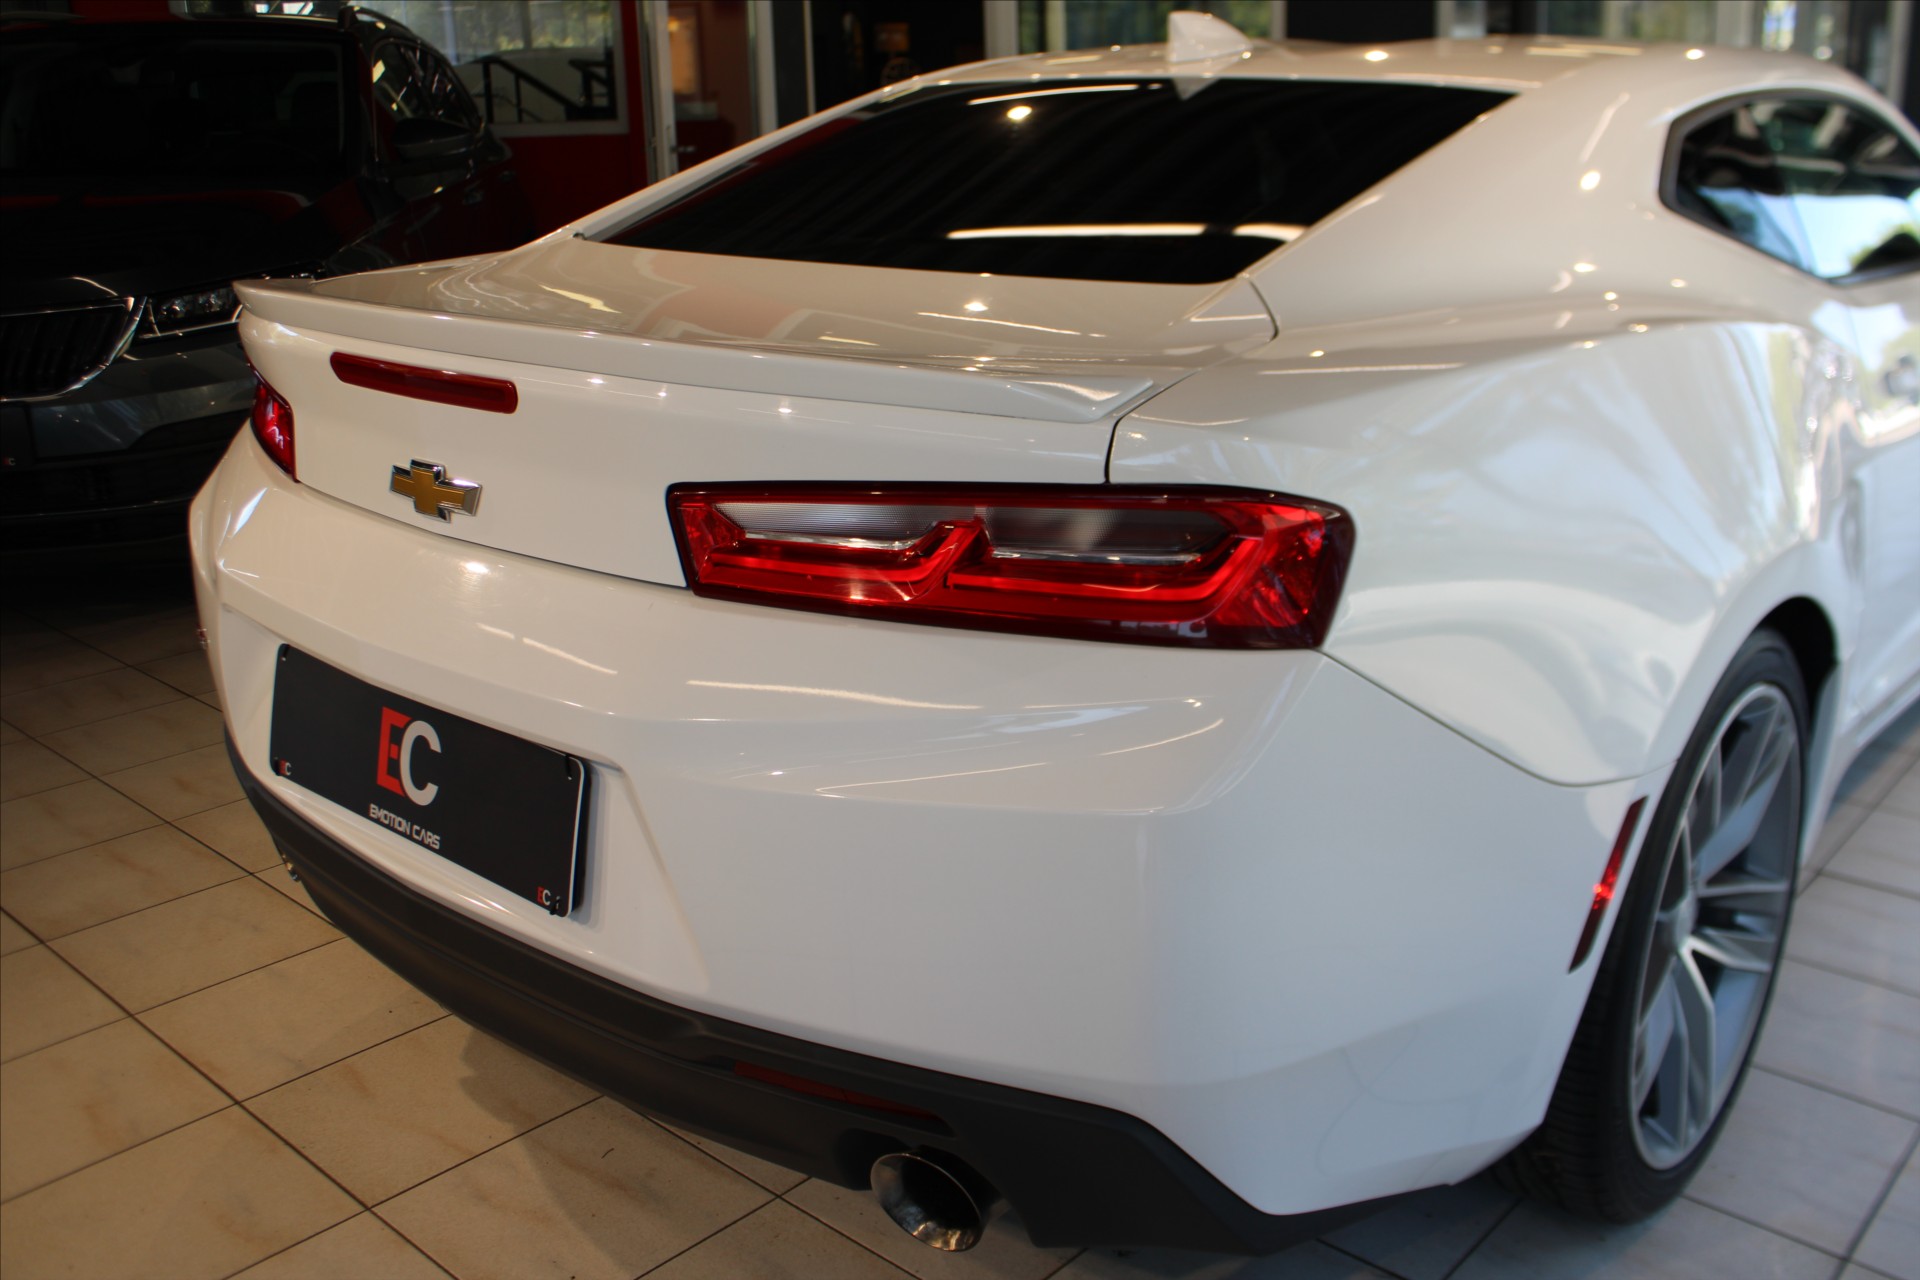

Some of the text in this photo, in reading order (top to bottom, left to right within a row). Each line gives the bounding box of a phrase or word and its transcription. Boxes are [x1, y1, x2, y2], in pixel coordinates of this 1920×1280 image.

[377, 706, 442, 806] EC
[369, 803, 441, 849] EMOTION CARS
[537, 886, 551, 906] EC
